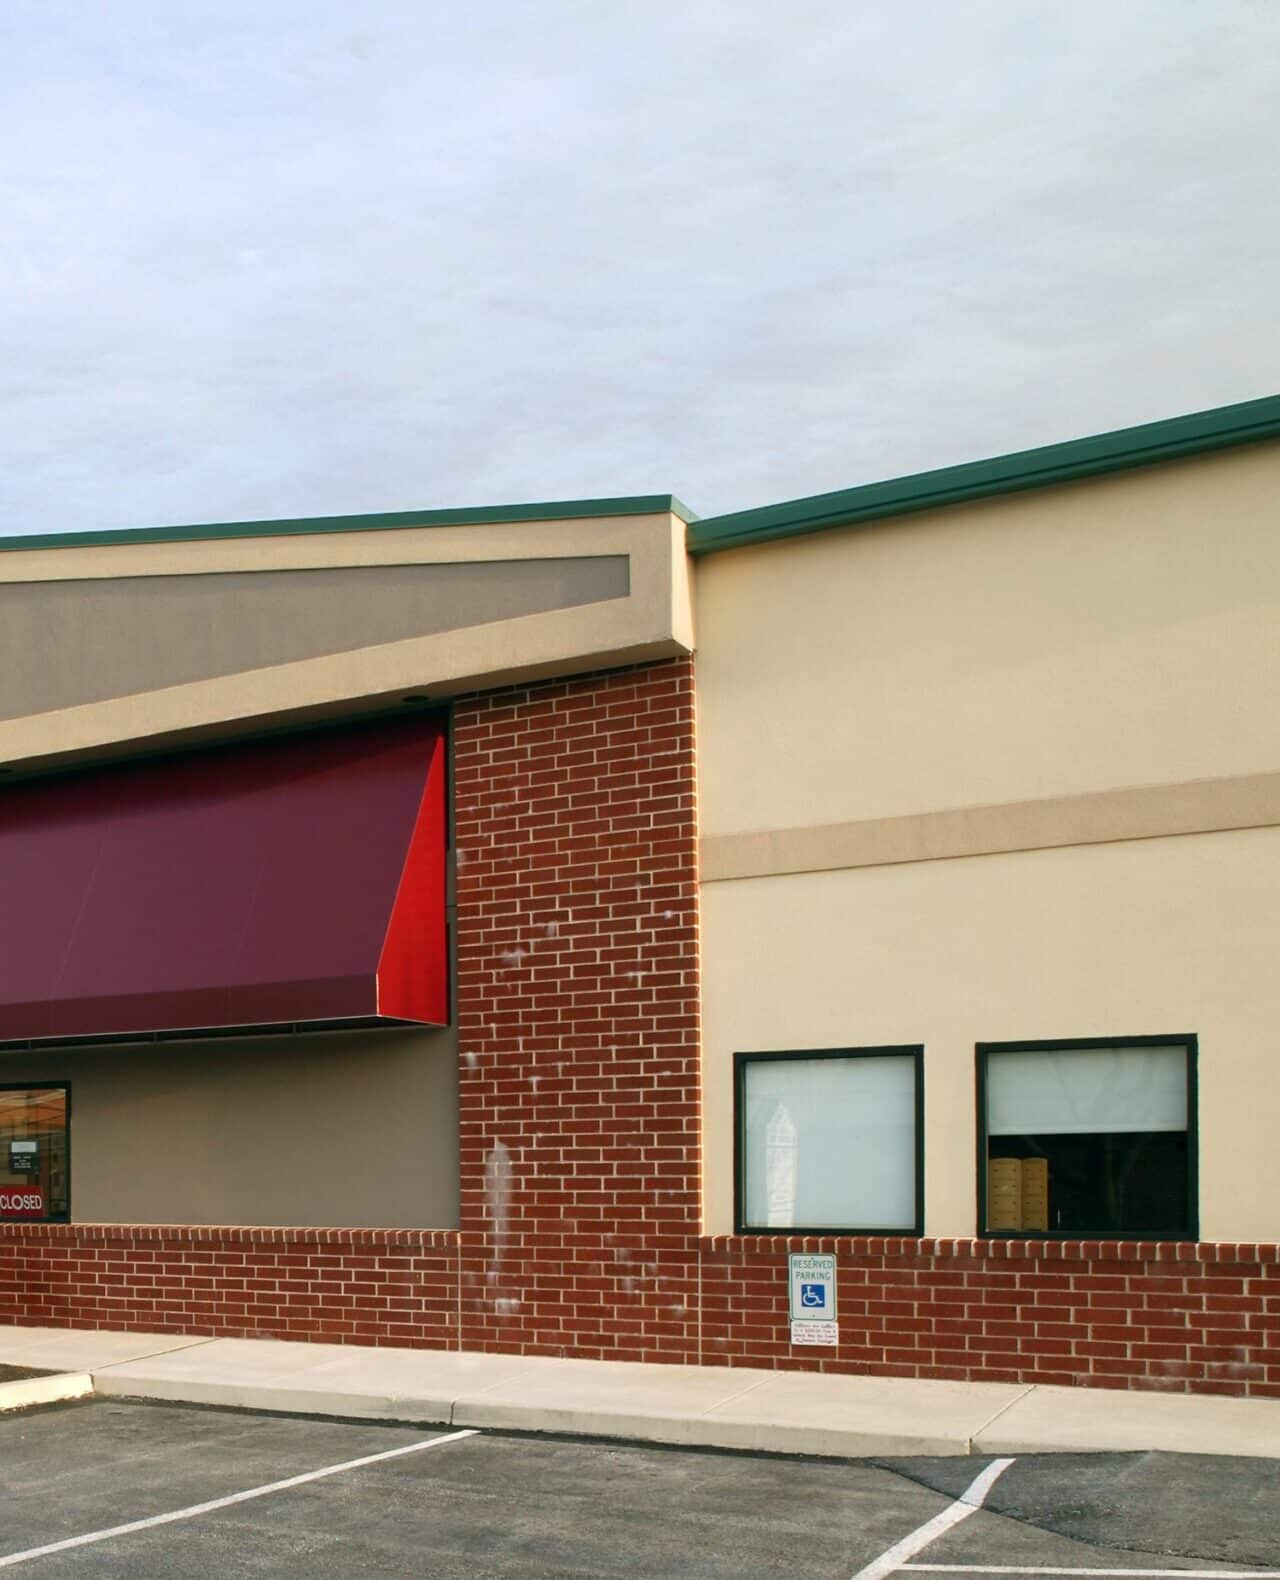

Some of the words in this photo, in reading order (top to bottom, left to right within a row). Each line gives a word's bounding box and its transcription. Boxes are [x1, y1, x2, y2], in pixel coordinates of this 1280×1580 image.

[0, 1195, 42, 1210] CLOSED
[793, 1259, 833, 1269] RESERVED
[795, 1271, 832, 1281] PARKING
